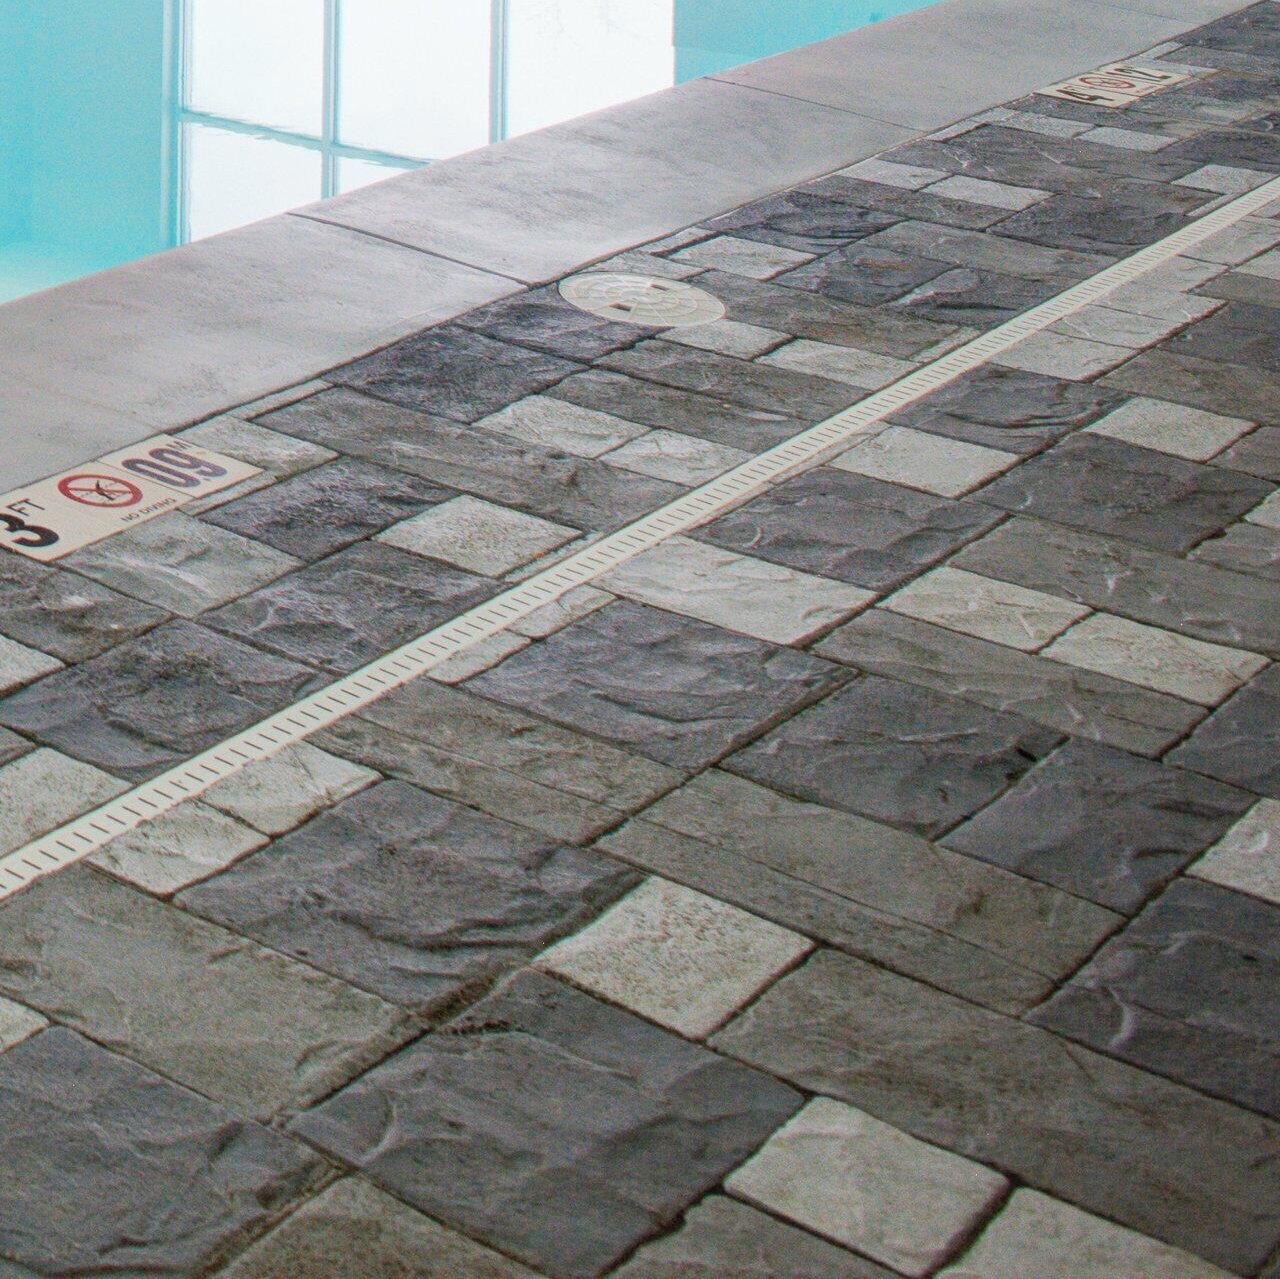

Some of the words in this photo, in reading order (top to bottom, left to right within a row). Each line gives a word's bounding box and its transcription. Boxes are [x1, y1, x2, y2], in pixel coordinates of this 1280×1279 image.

[6, 497, 46, 517] FT
[120, 511, 140, 522] NO
[139, 496, 177, 515] DIVING
